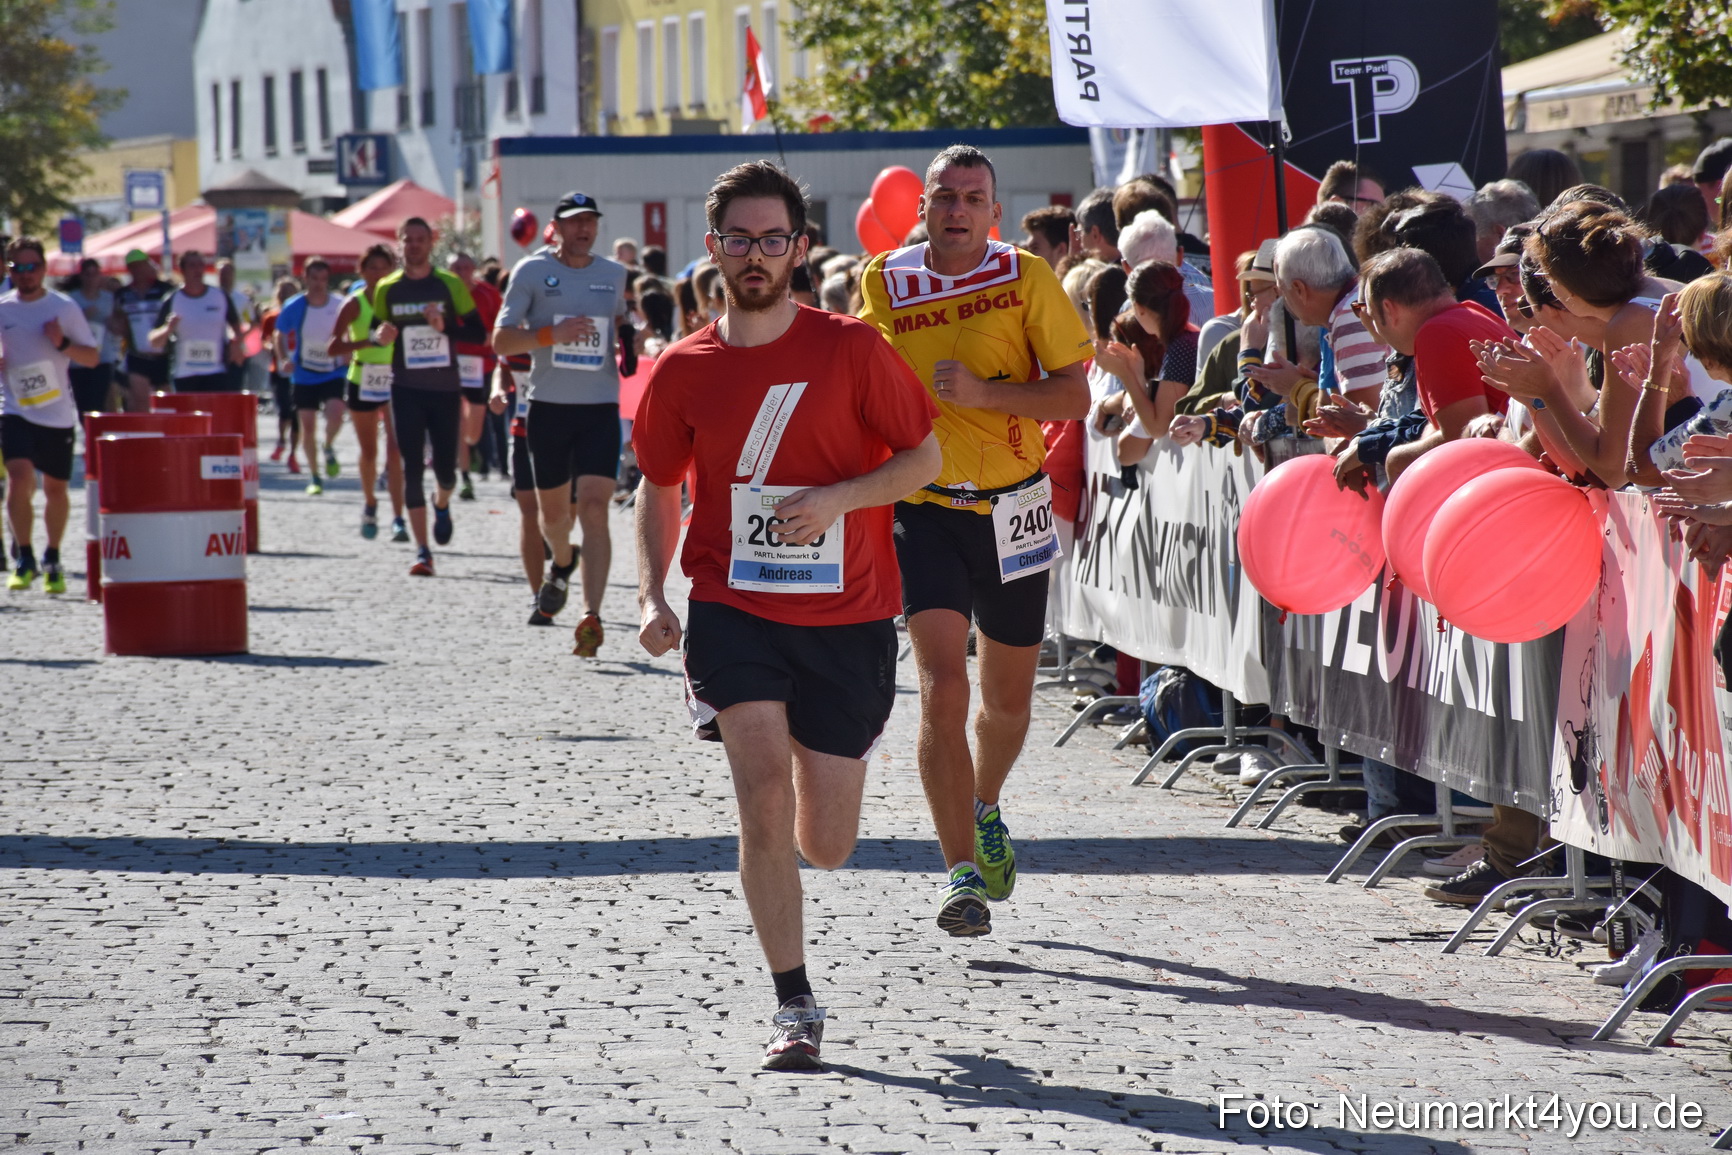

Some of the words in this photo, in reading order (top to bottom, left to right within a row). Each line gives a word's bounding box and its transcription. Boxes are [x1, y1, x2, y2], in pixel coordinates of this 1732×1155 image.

[893, 308, 951, 336] MAX
[956, 289, 1024, 322] BÖGL
[410, 337, 441, 352] 2527
[20, 374, 47, 392] 329
[742, 393, 780, 466] Bierschneider
[758, 443, 775, 474] Menschen
[771, 430, 780, 444] und
[1017, 486, 1047, 508] BOCK
[754, 550, 775, 560] PARTL
[1015, 542, 1033, 551] PARTL
[758, 565, 813, 580] Andreas
